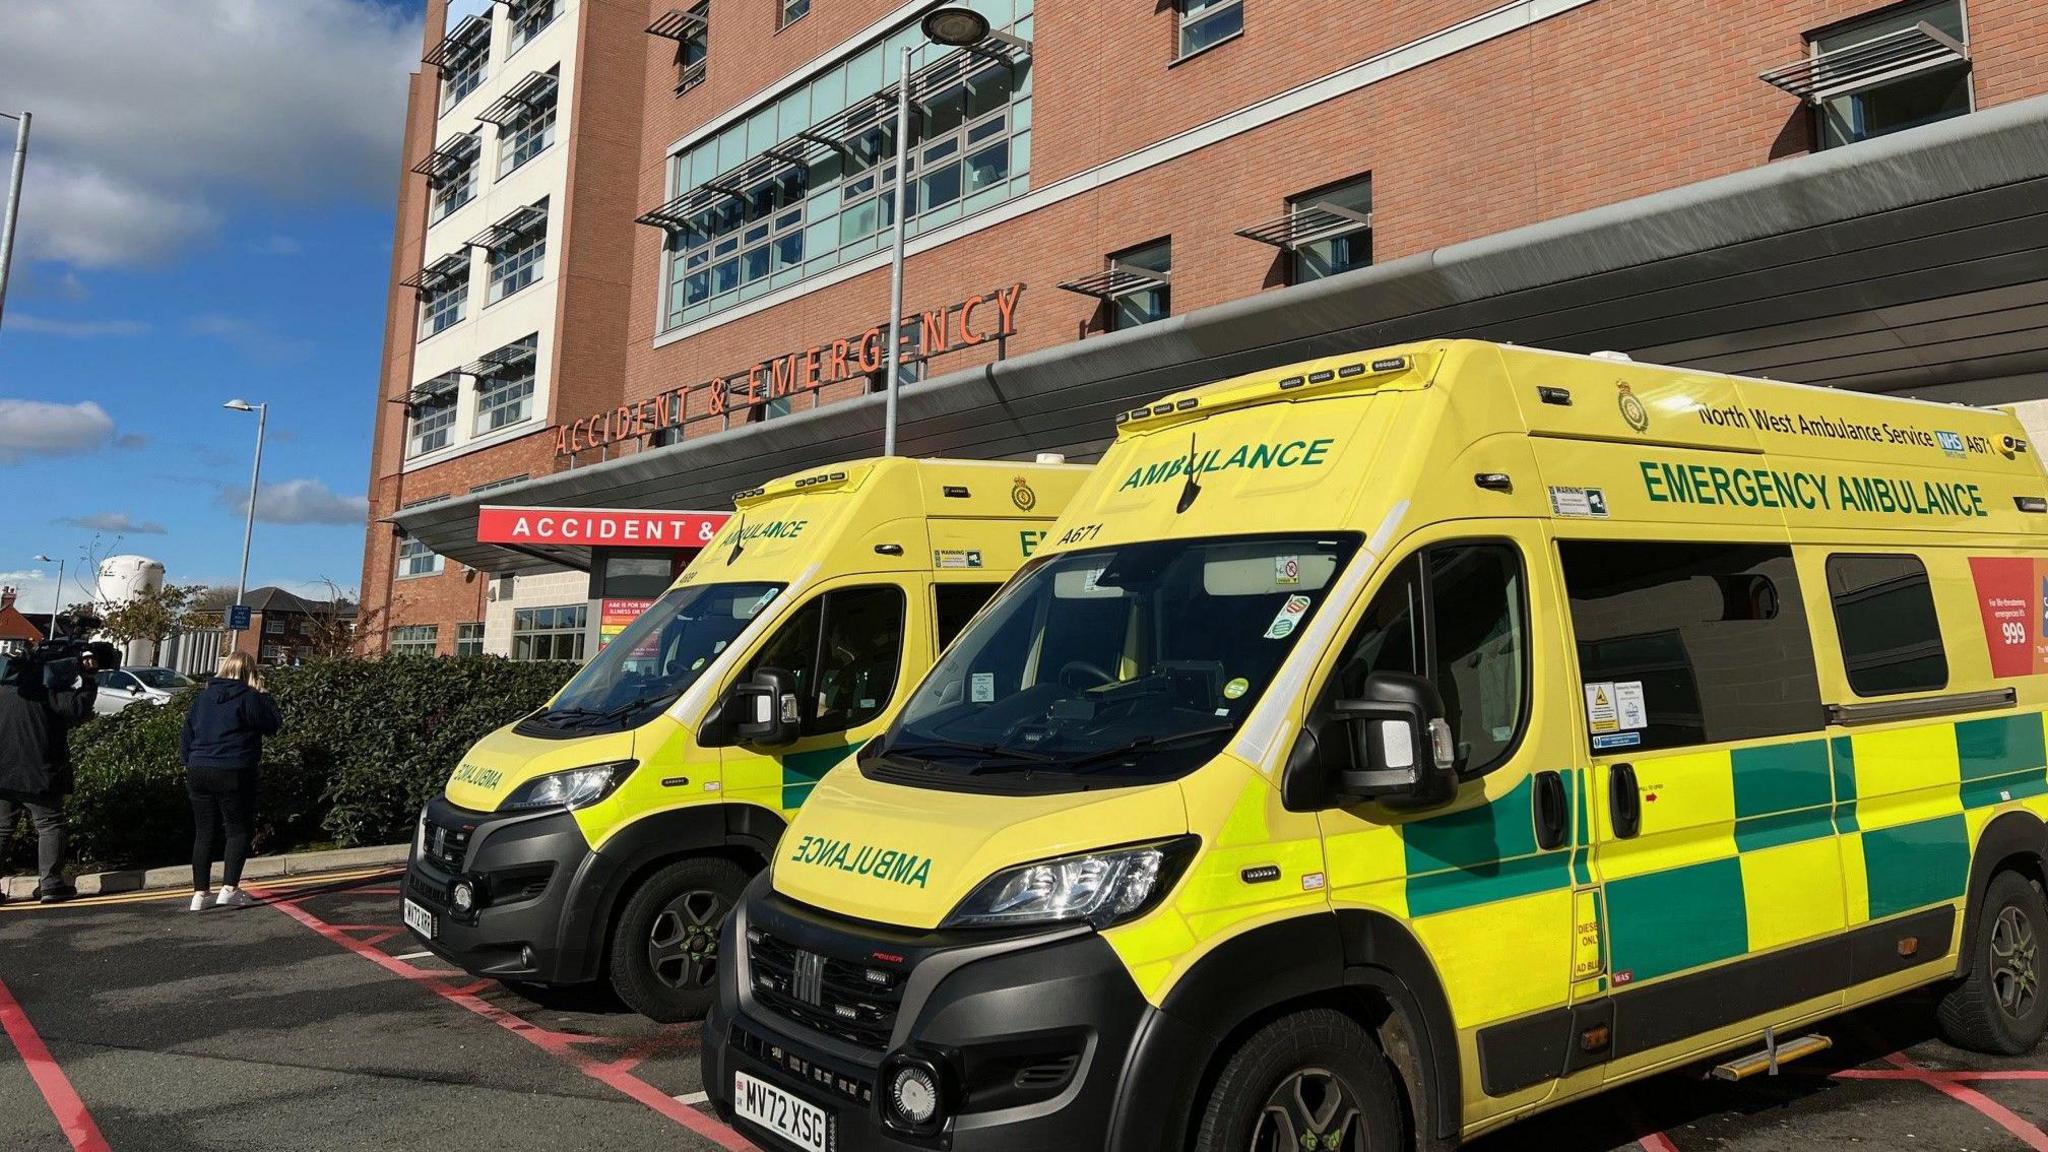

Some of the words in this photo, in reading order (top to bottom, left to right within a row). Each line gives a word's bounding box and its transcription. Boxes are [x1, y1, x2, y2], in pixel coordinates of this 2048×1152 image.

[555, 387, 690, 456] ACCIDENT
[708, 377, 726, 416] &
[1698, 403, 1750, 428] North
[1749, 408, 1797, 434] West
[1799, 414, 1883, 443] Ambulance
[1882, 423, 1934, 447] Service
[1936, 431, 1964, 450] NHS
[1965, 435, 1995, 455] A671
[1118, 439, 1335, 492] AMBULANCE
[1639, 461, 1831, 510] EMERGENCY
[1838, 476, 1988, 517] AMBULANCE
[511, 517, 686, 540] ACCIDENT
[698, 521, 715, 540] &
[1057, 522, 1104, 546] A671
[2002, 622, 2026, 645] 999
[1578, 922, 1600, 934] DIESE
[746, 1080, 788, 1131] MV72
[791, 1101, 823, 1149] XSG
